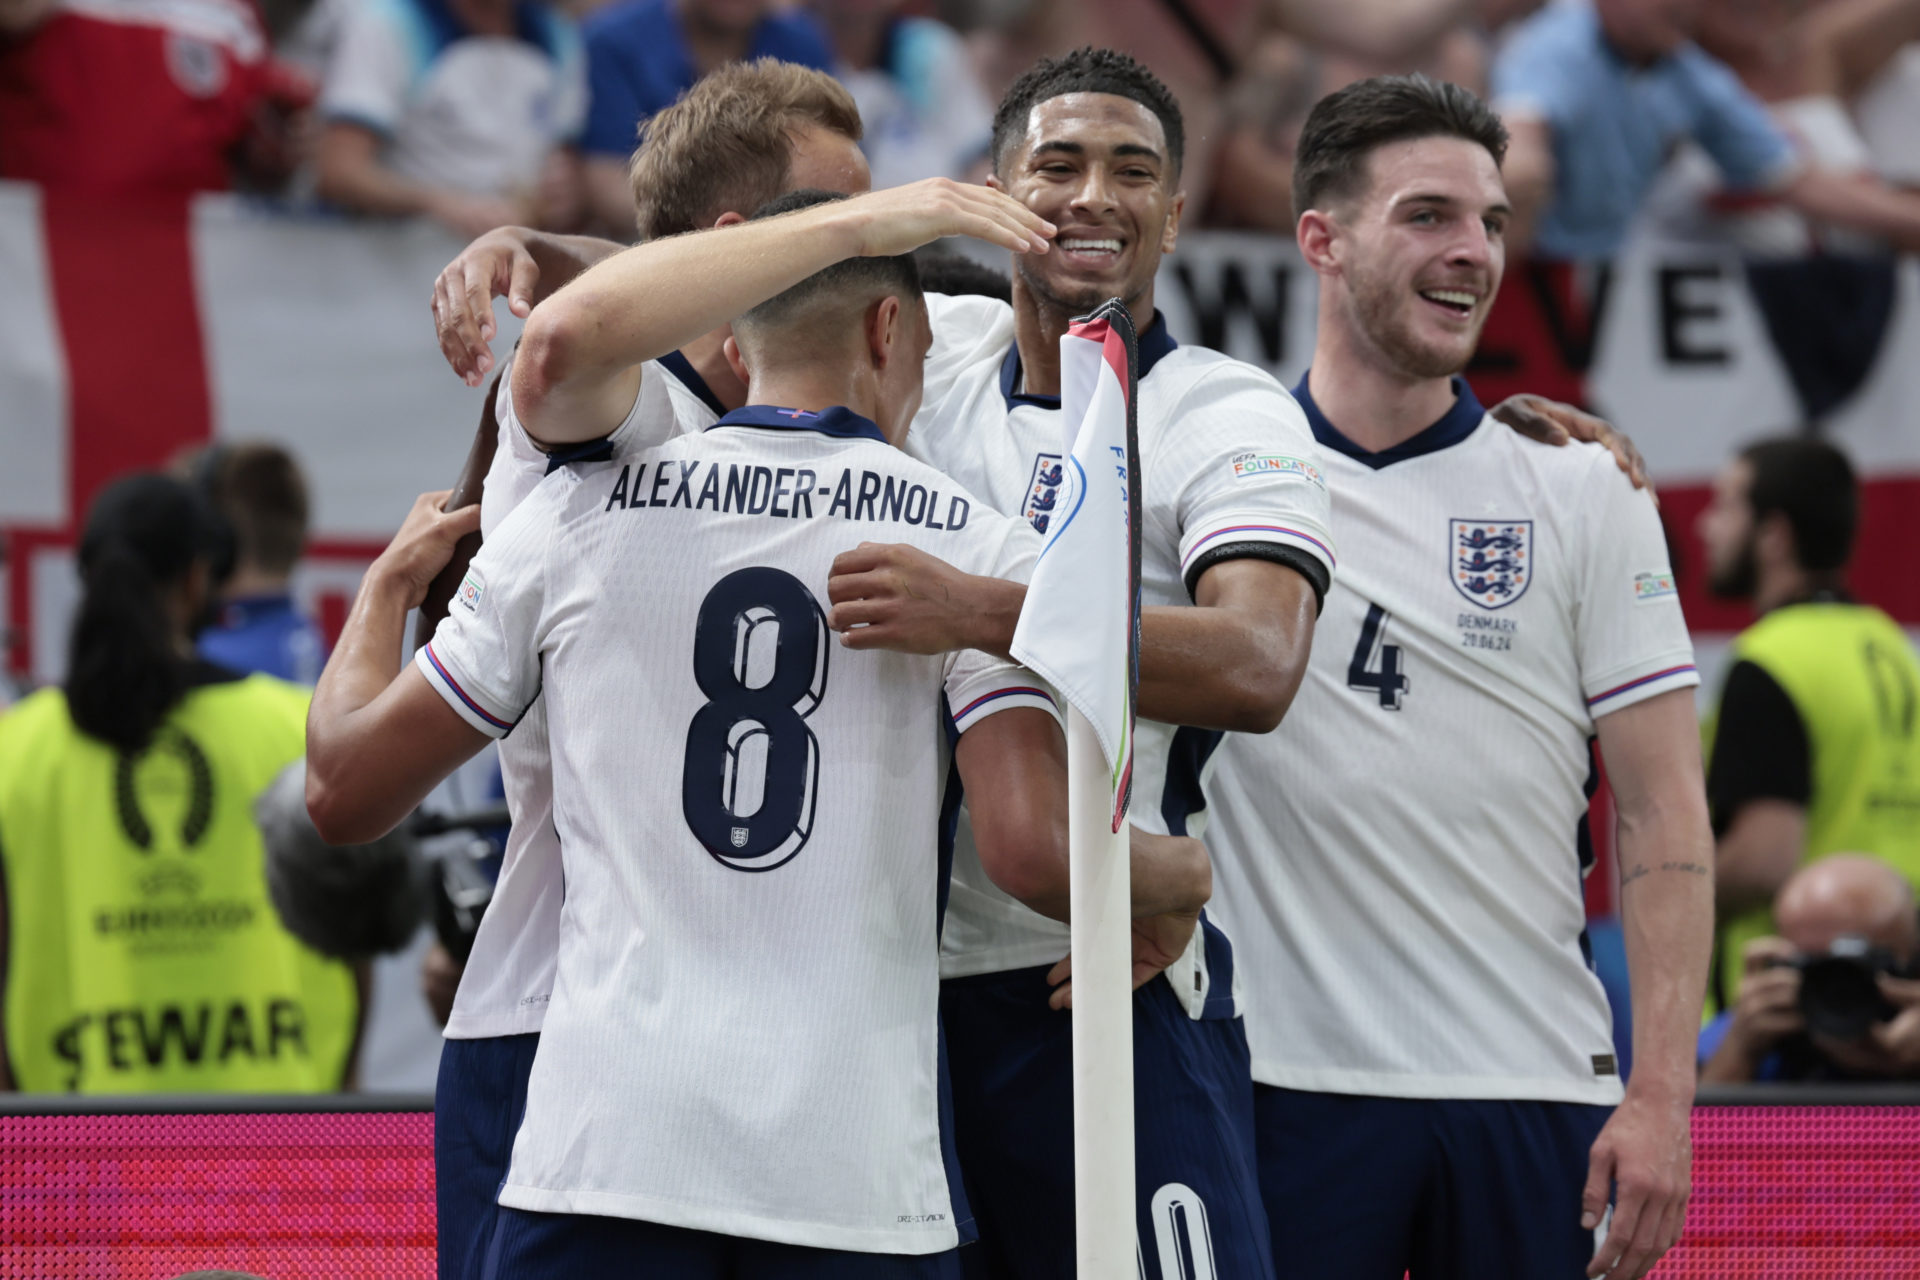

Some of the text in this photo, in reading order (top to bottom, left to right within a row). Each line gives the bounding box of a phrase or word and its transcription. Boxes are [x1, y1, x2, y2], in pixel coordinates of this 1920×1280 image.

[1232, 453, 1257, 463] UEFA
[604, 459, 971, 532] ALEXANDER-ARNOLD
[1347, 601, 1410, 711] 4
[1457, 613, 1518, 633] DENMARK
[682, 566, 831, 873] 8
